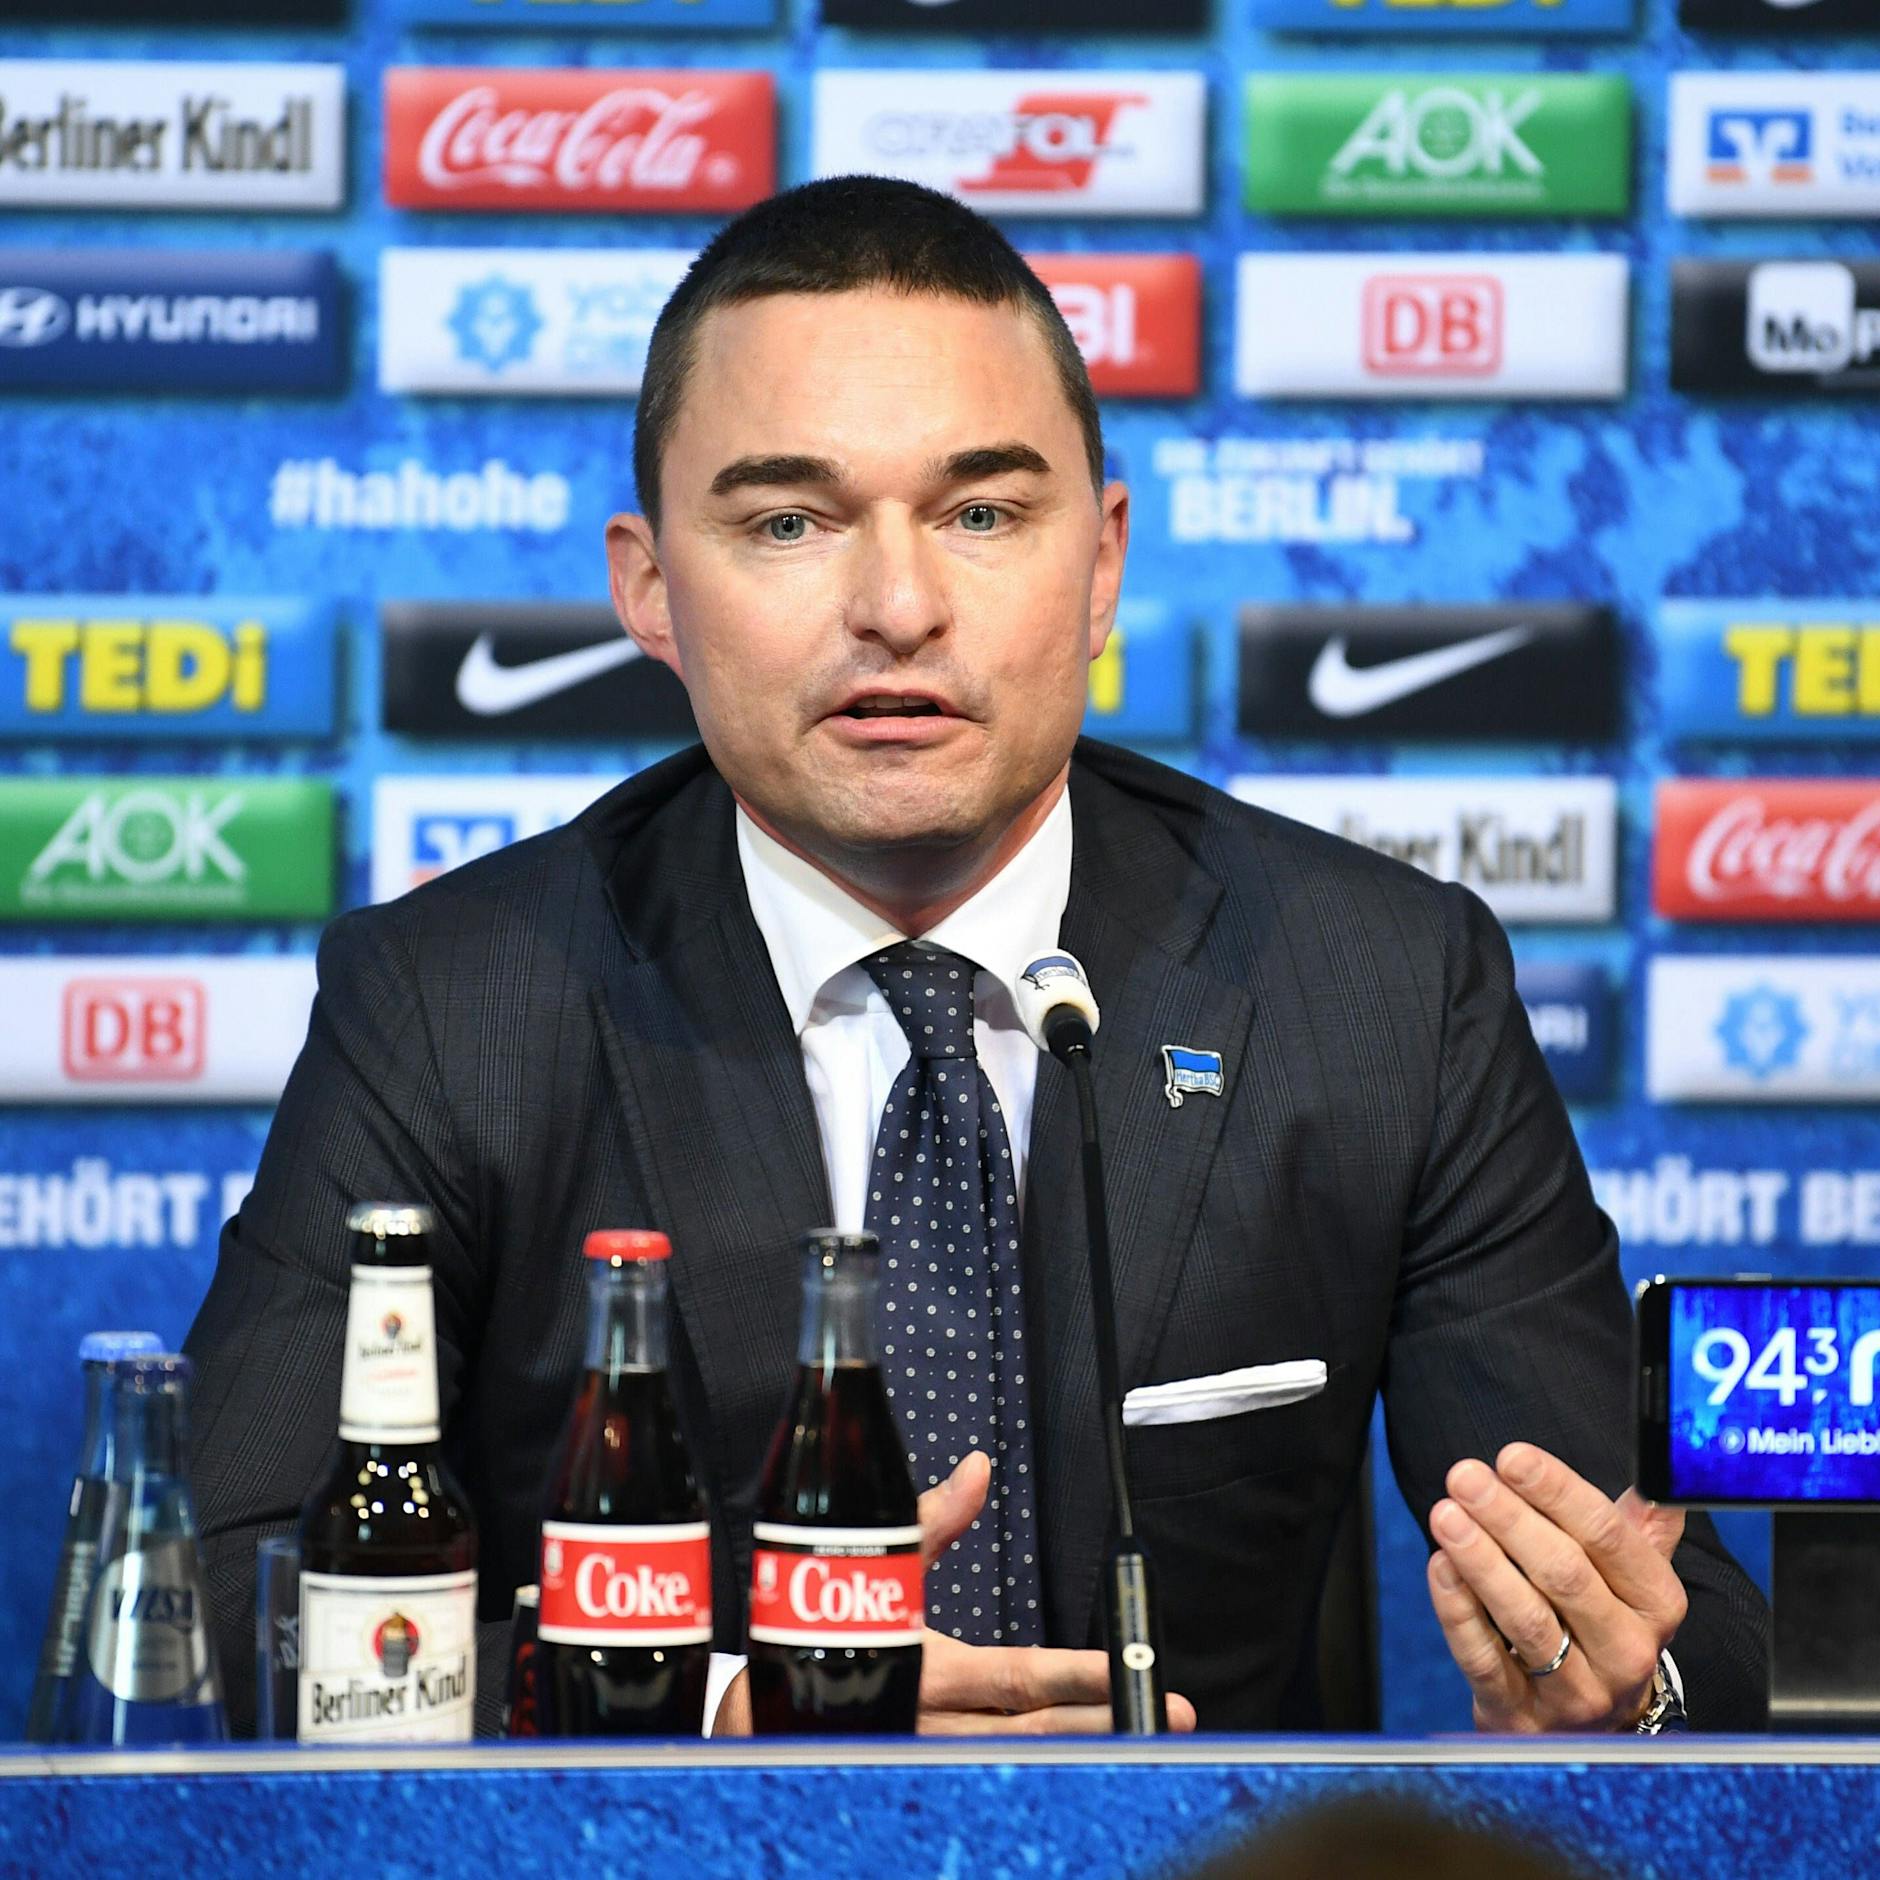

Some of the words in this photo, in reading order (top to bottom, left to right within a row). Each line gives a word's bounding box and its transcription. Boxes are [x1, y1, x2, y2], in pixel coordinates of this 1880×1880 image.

[0, 95, 165, 173] erliner
[181, 95, 313, 173] Kindl
[1330, 87, 1545, 178] AOK
[75, 296, 319, 343] HYUNDAI
[1383, 296, 1482, 356] DB
[269, 458, 571, 532] #hahohe
[11, 619, 266, 712] TEDi
[30, 791, 246, 882] AOK
[1456, 810, 1586, 884] Kindl
[84, 1000, 183, 1058] DB
[1747, 1427, 1815, 1454] Mein
[313, 1679, 407, 1724] Berliner
